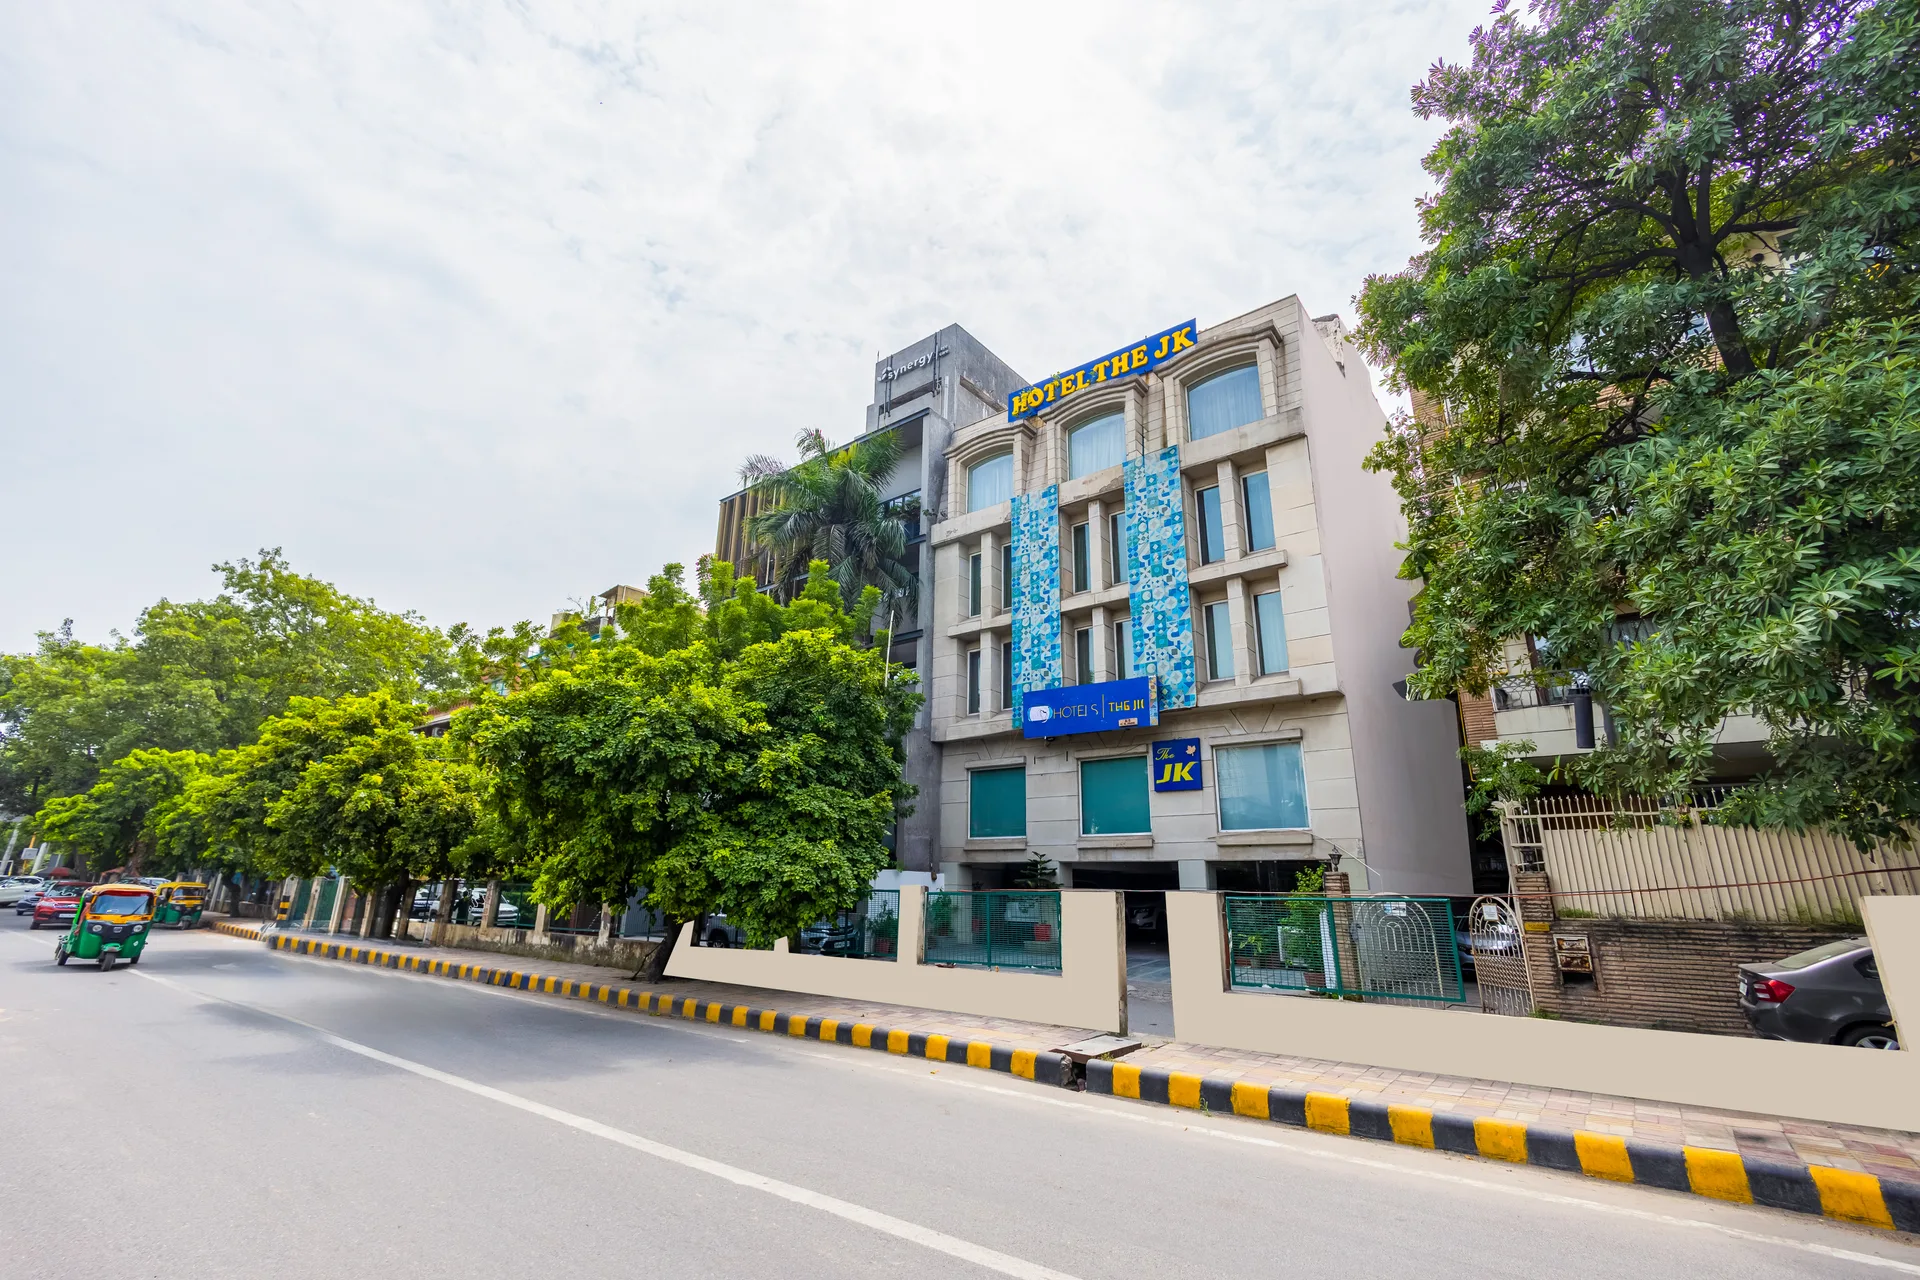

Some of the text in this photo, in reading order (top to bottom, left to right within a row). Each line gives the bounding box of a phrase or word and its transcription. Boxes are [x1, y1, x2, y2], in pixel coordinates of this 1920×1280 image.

[1012, 327, 1194, 416] HOTEL THE JK
[1155, 747, 1175, 760] The
[1156, 761, 1199, 784] JK
